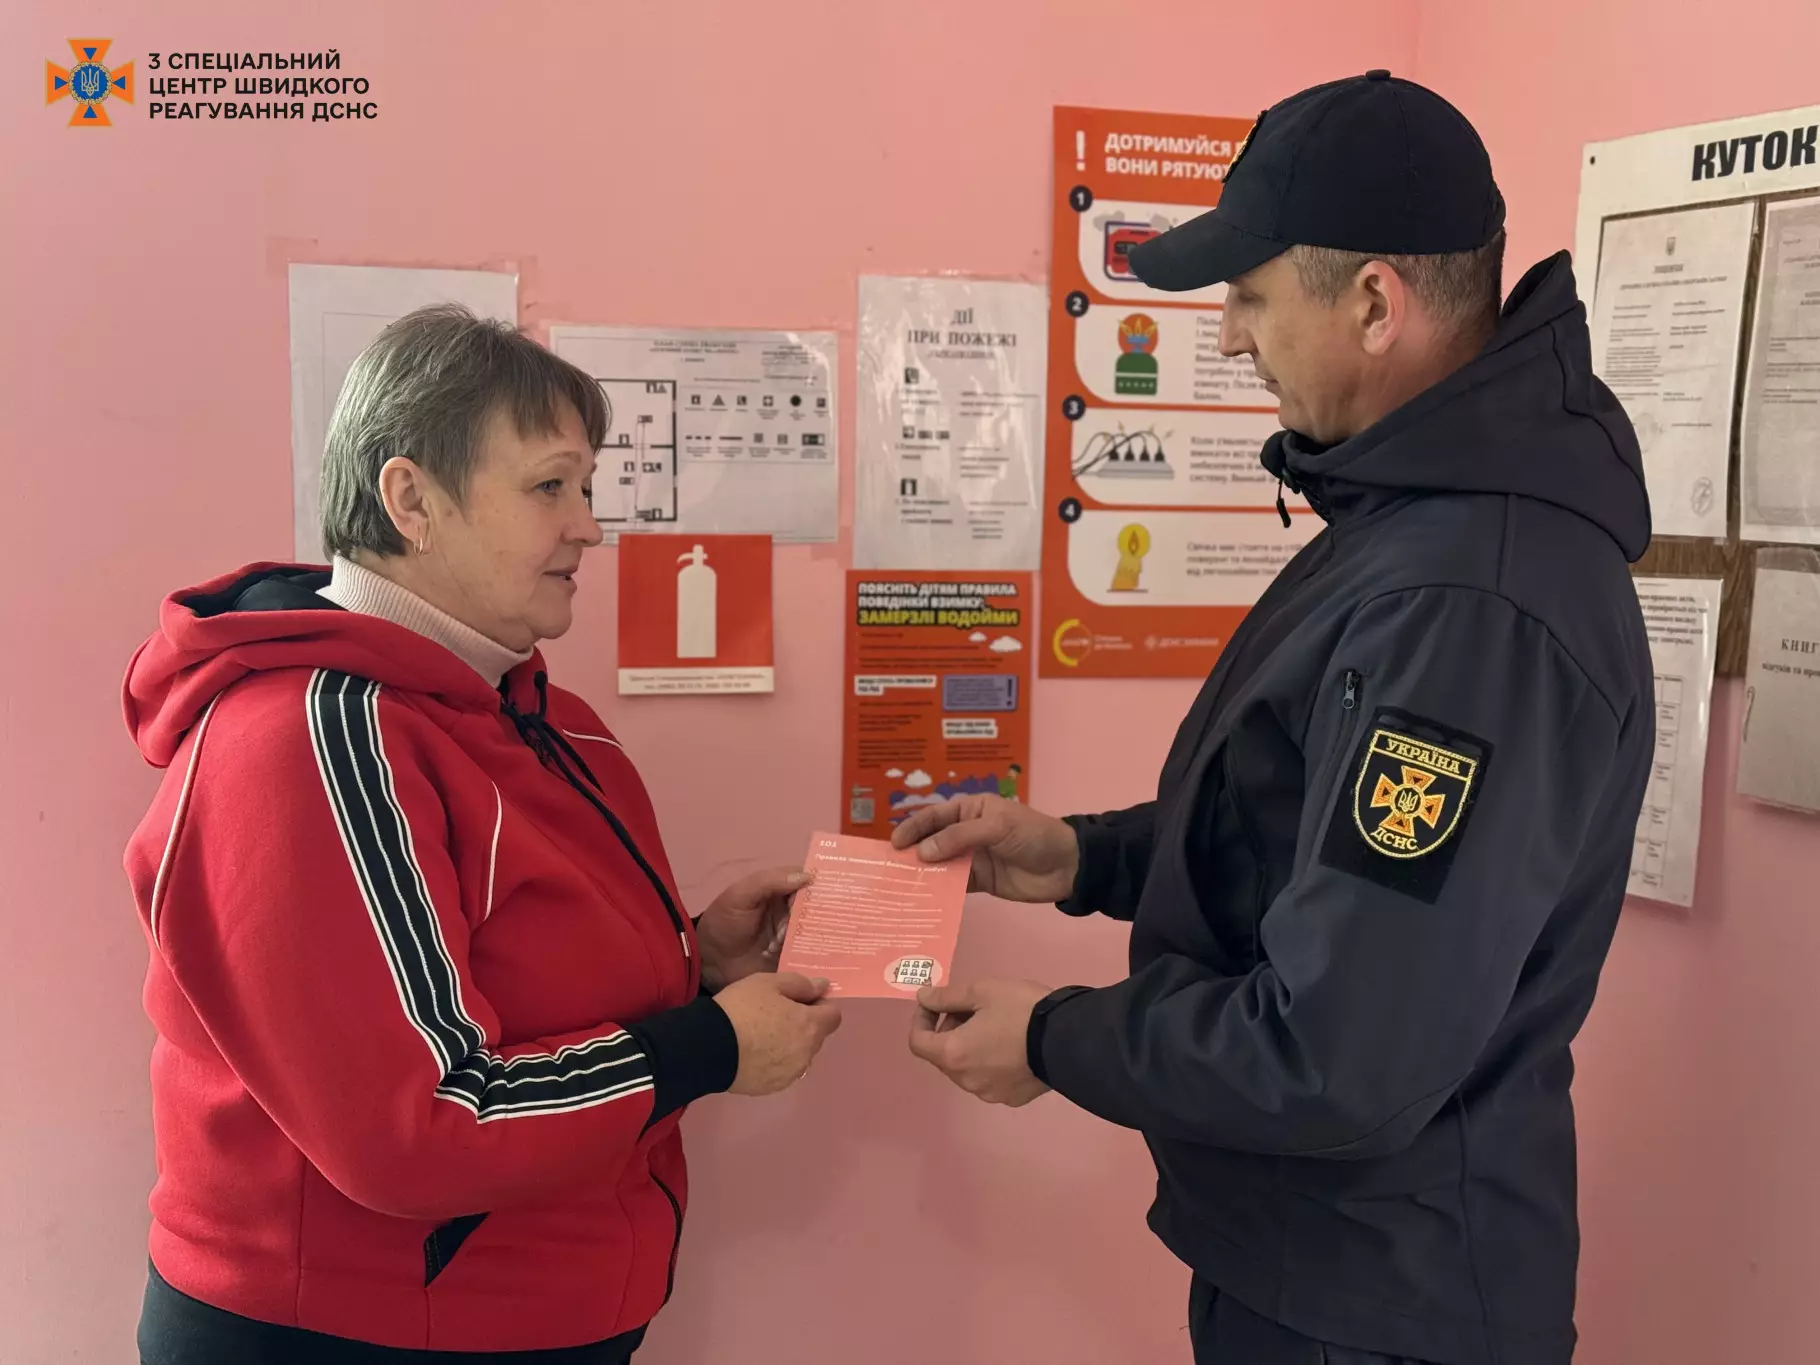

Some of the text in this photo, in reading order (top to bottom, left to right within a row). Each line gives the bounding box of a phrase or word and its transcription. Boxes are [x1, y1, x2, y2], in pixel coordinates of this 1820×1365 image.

[1104, 132, 1231, 157] ДОТРИМУЙСЯ
[1692, 125, 1819, 181] КУТОК
[1105, 157, 1158, 176] ВОНИ
[1076, 192, 1085, 206] 1
[1072, 297, 1082, 311] 2
[950, 307, 973, 325] ДІЇ
[908, 330, 1017, 347] ПРИ ПОЖЕЖІ
[1069, 401, 1079, 415] 3
[1065, 503, 1076, 518] 4
[858, 583, 1017, 598] ПОЯСНІТЬ ДІТЯМ ПРАВИЛА
[858, 596, 929, 610] ПОВЕДІНКИ
[859, 607, 1018, 628] ЗАМЕРЗЛІ ВОДОЙМИ
[1386, 738, 1460, 774] УКРАЇНА
[1371, 827, 1418, 851] ДСНС
